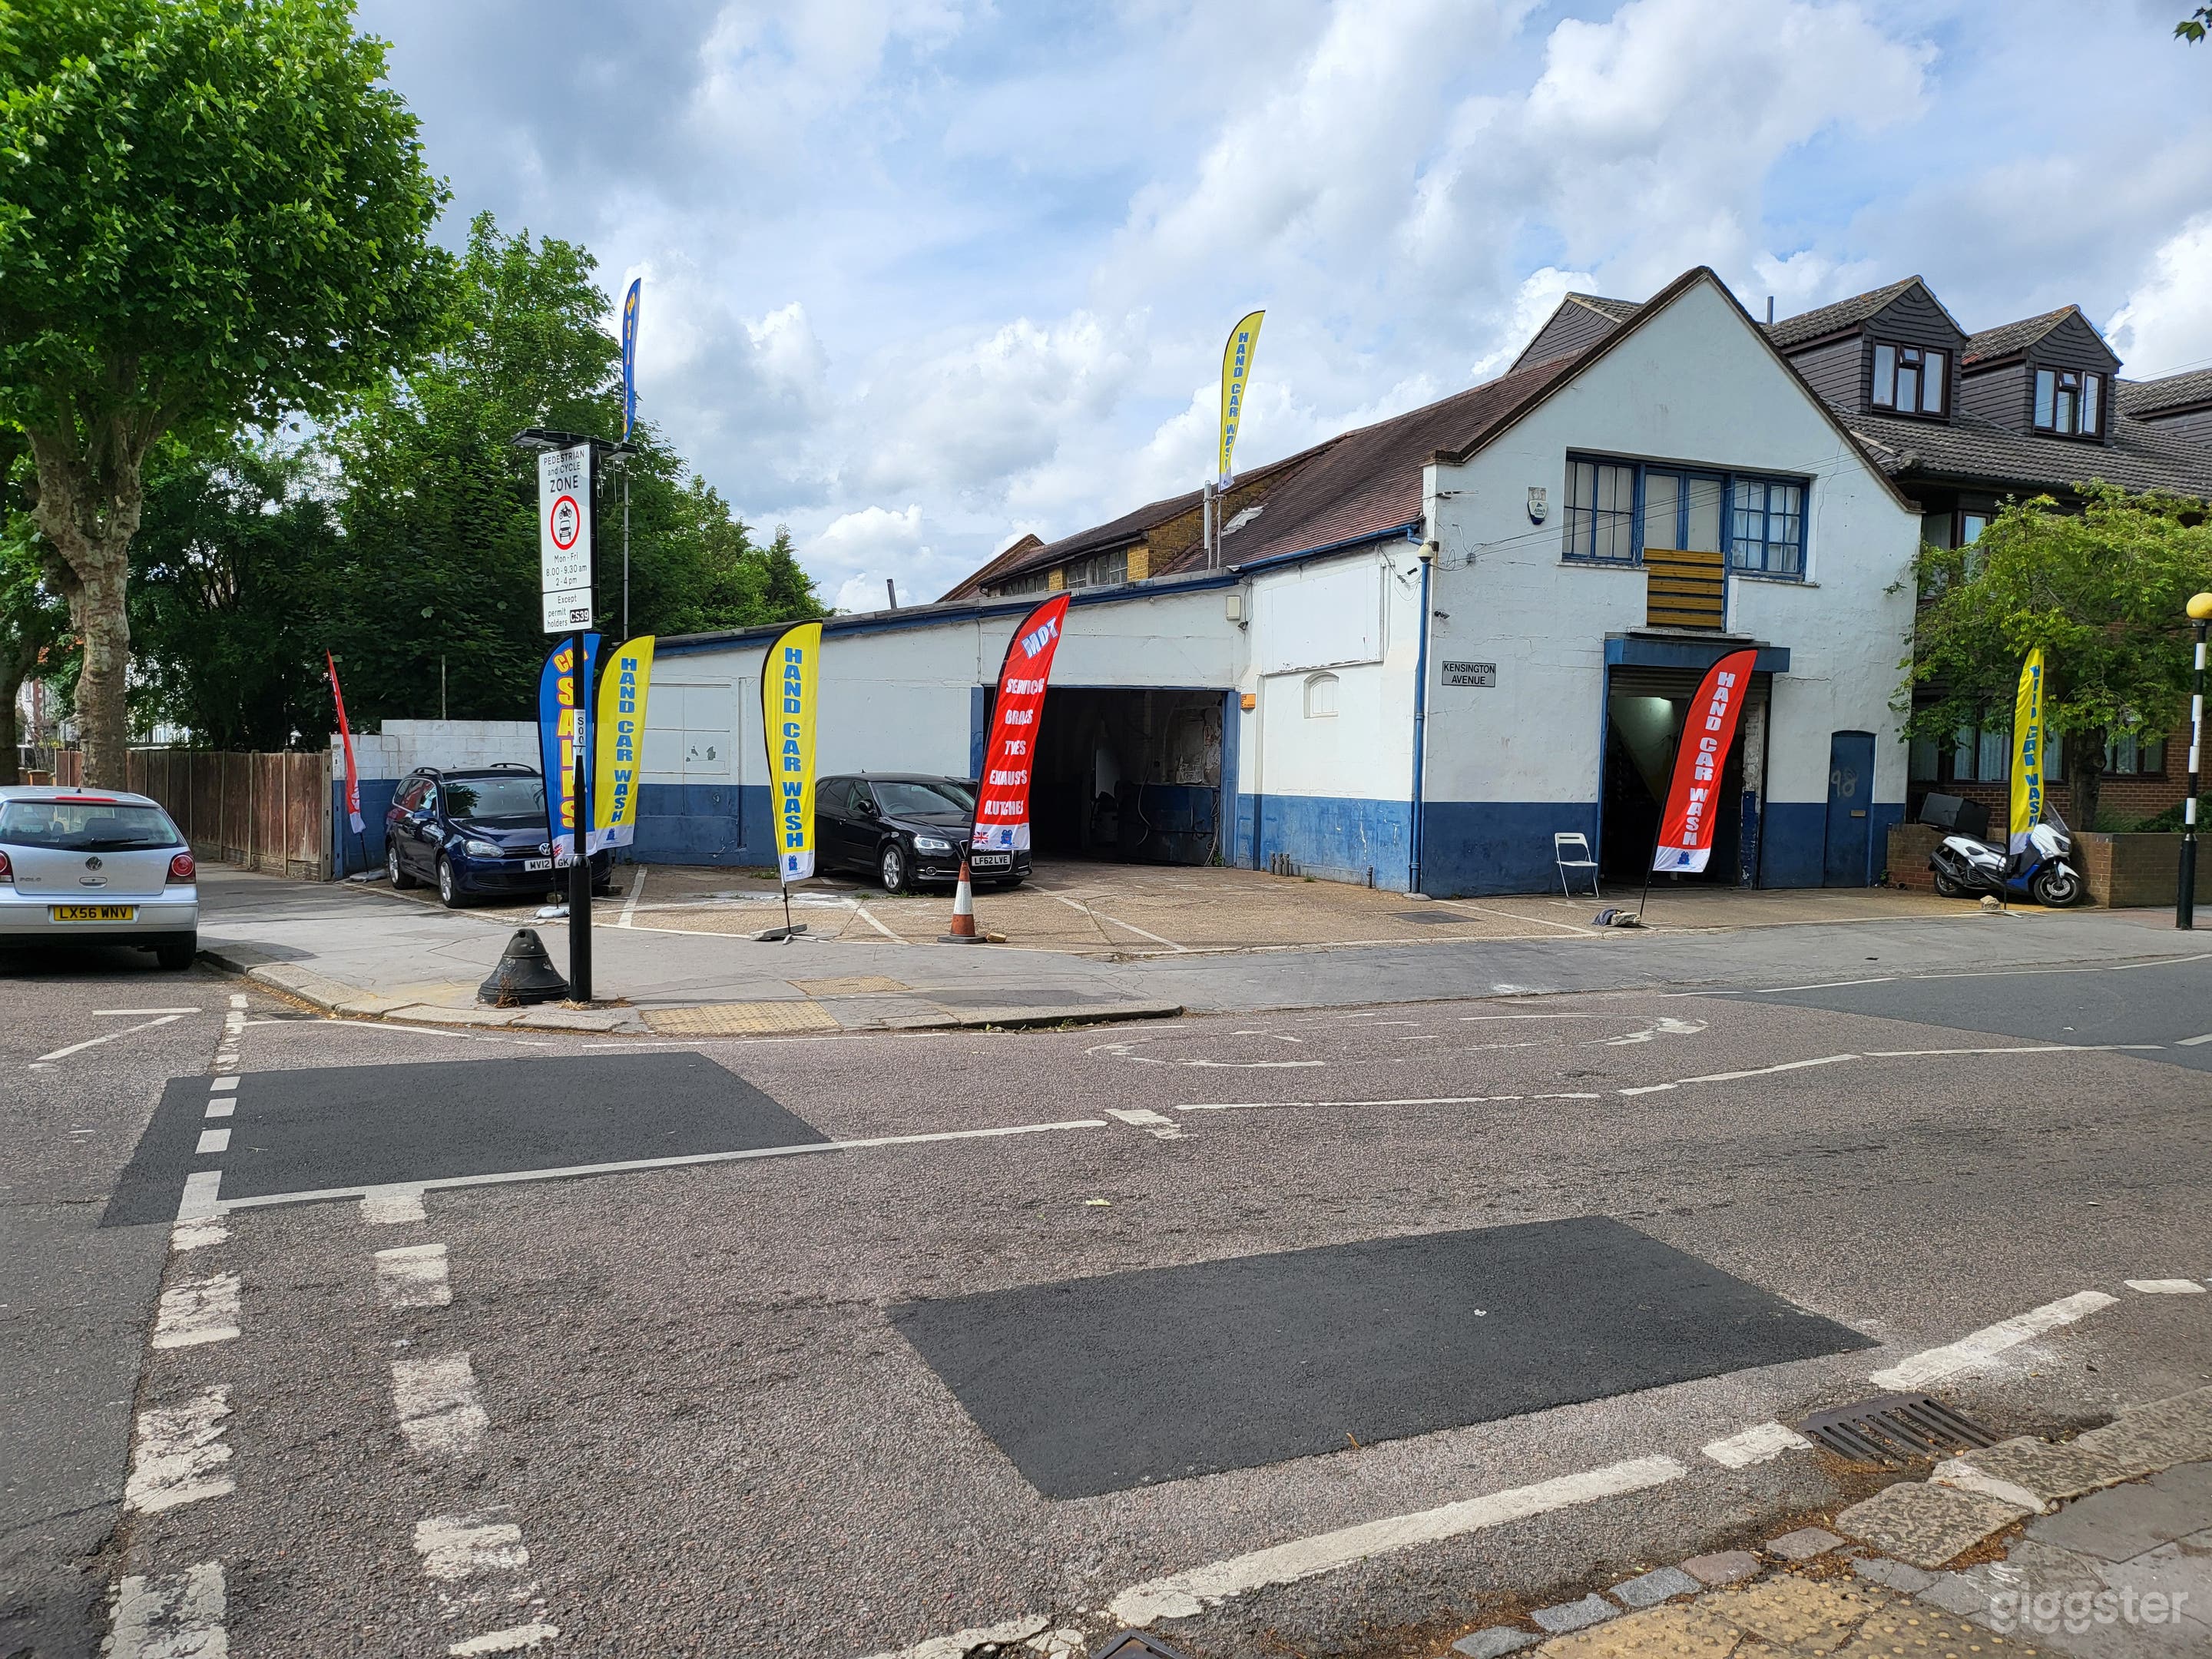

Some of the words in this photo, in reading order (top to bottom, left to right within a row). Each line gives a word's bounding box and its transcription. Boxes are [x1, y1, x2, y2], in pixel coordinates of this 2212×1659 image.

[1233, 333, 1249, 378] HAND
[1229, 384, 1241, 417] CAR
[544, 449, 584, 465] PEDESTRIAN
[548, 466, 558, 475] and
[560, 462, 581, 473] CYCLE
[550, 475, 578, 492] ZONE
[569, 578, 577, 586] pm
[558, 594, 577, 604] Except
[548, 608, 566, 618] permit
[570, 610, 588, 622] CS39
[548, 619, 568, 628] holders
[1022, 616, 1058, 658] MOT
[1444, 664, 1495, 674] KENSINGTON
[619, 657, 637, 713] HAND
[783, 647, 802, 714] HAND
[1452, 675, 1485, 684] AVENUE
[1705, 671, 1736, 730] HAND
[616, 720, 634, 761] CAR
[782, 723, 800, 771] CAR
[1694, 737, 1717, 781] CAR
[611, 770, 632, 823] WASH
[782, 782, 803, 848] WASH
[1683, 788, 1708, 845] WASH
[530, 860, 551, 869] MV12
[975, 856, 992, 865] LF62
[994, 856, 1008, 864] LVE
[60, 908, 97, 919] LX56
[101, 908, 127, 919] WNV
